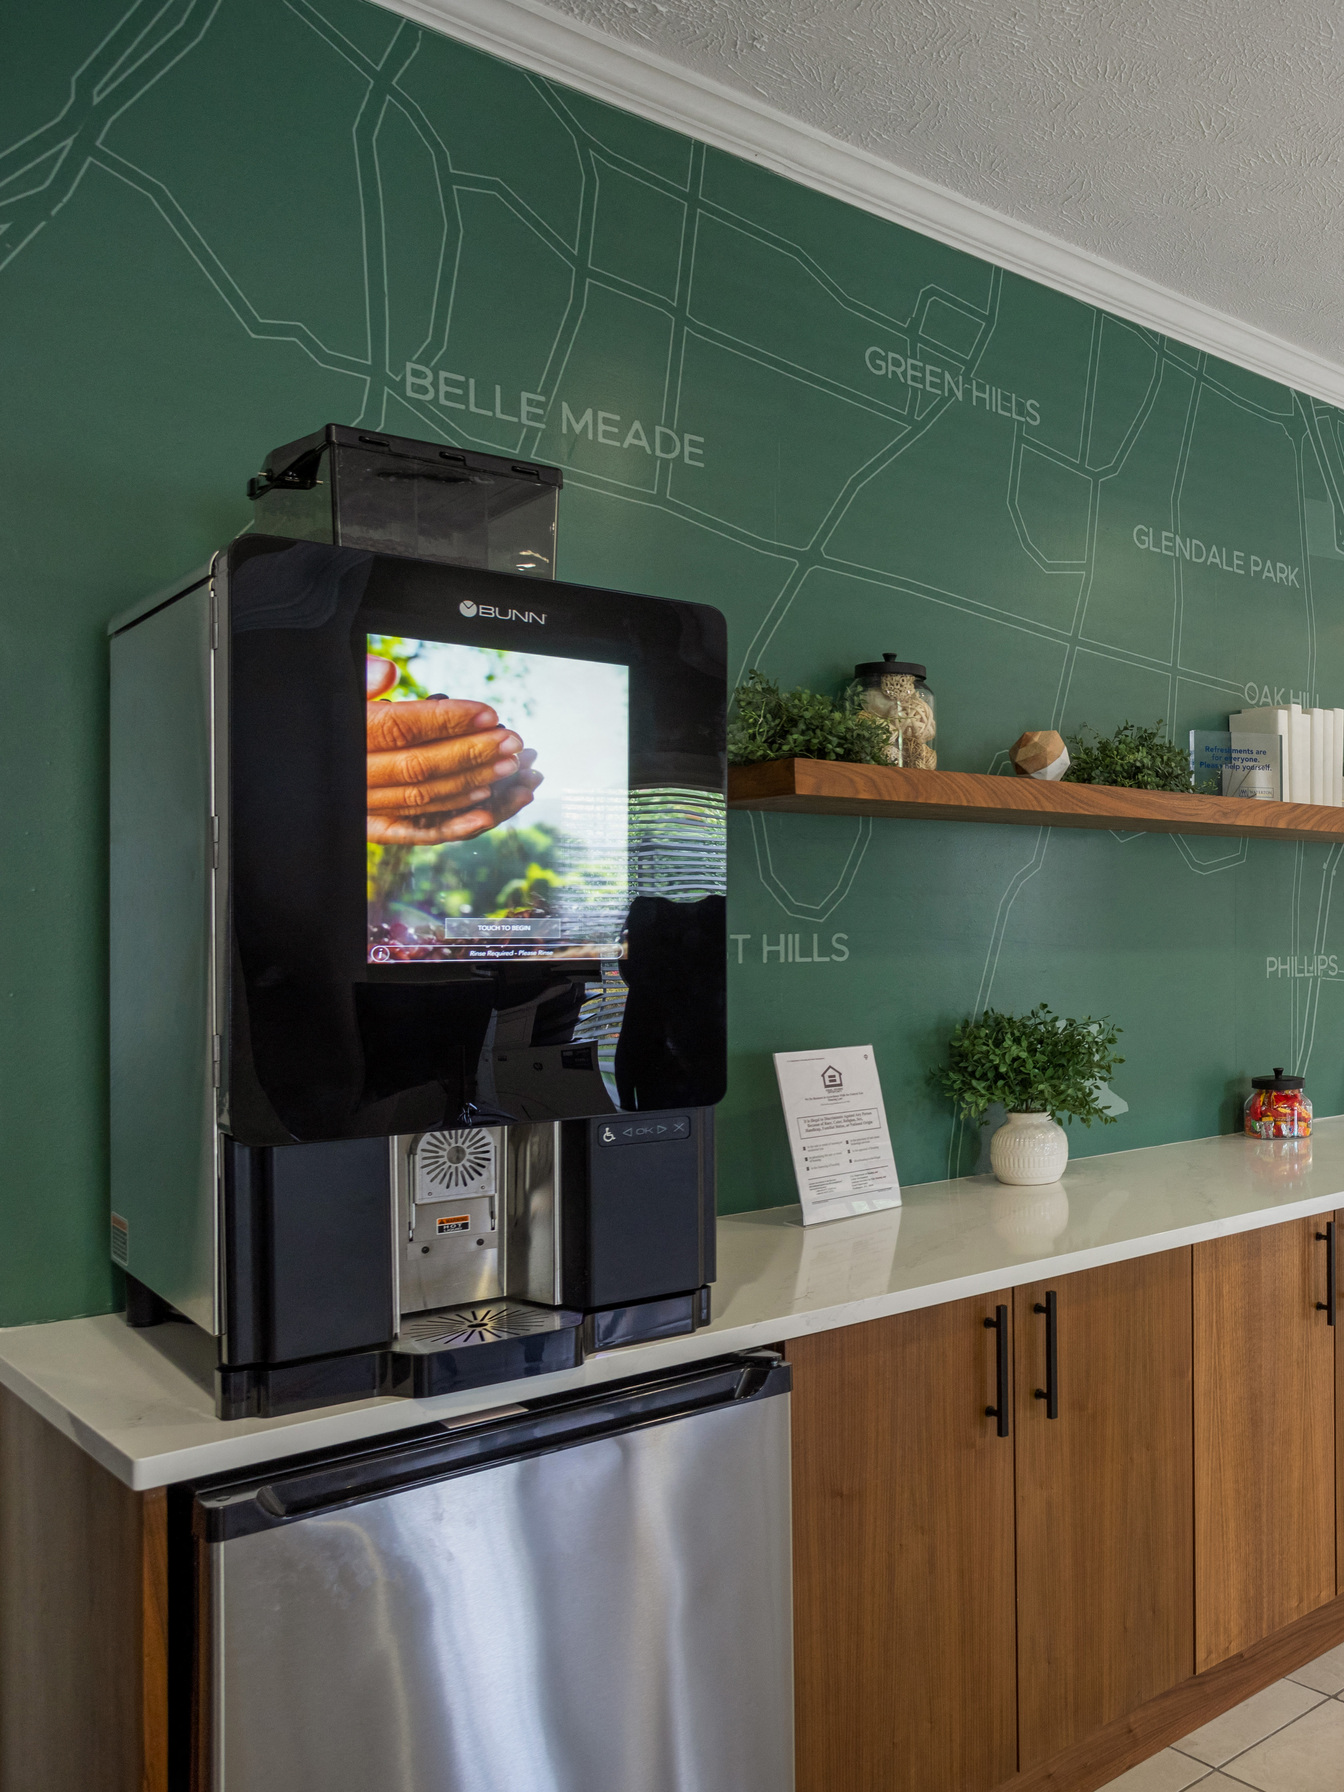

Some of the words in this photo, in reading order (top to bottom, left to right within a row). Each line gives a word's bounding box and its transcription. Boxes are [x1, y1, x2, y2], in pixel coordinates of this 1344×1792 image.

[864, 346, 963, 402] GREEN
[972, 379, 1041, 426] HILLS
[405, 361, 546, 429] BELLE
[561, 401, 705, 468] MEADE
[1133, 524, 1245, 575] GLENDALE
[1250, 555, 1300, 588] PARK
[479, 604, 545, 625] BUNN
[1244, 681, 1285, 706] OAK
[1204, 745, 1254, 755] Refreshments
[1211, 753, 1222, 761] for
[1224, 756, 1260, 764] everyone.
[1199, 761, 1223, 769] Please
[1224, 763, 1241, 772] help
[1242, 763, 1272, 772] yourself.
[486, 950, 514, 958] Required
[726, 933, 752, 964] T
[762, 932, 850, 964] HILLS
[1266, 954, 1338, 979] PHILLIPS
[635, 1127, 654, 1135] OK
